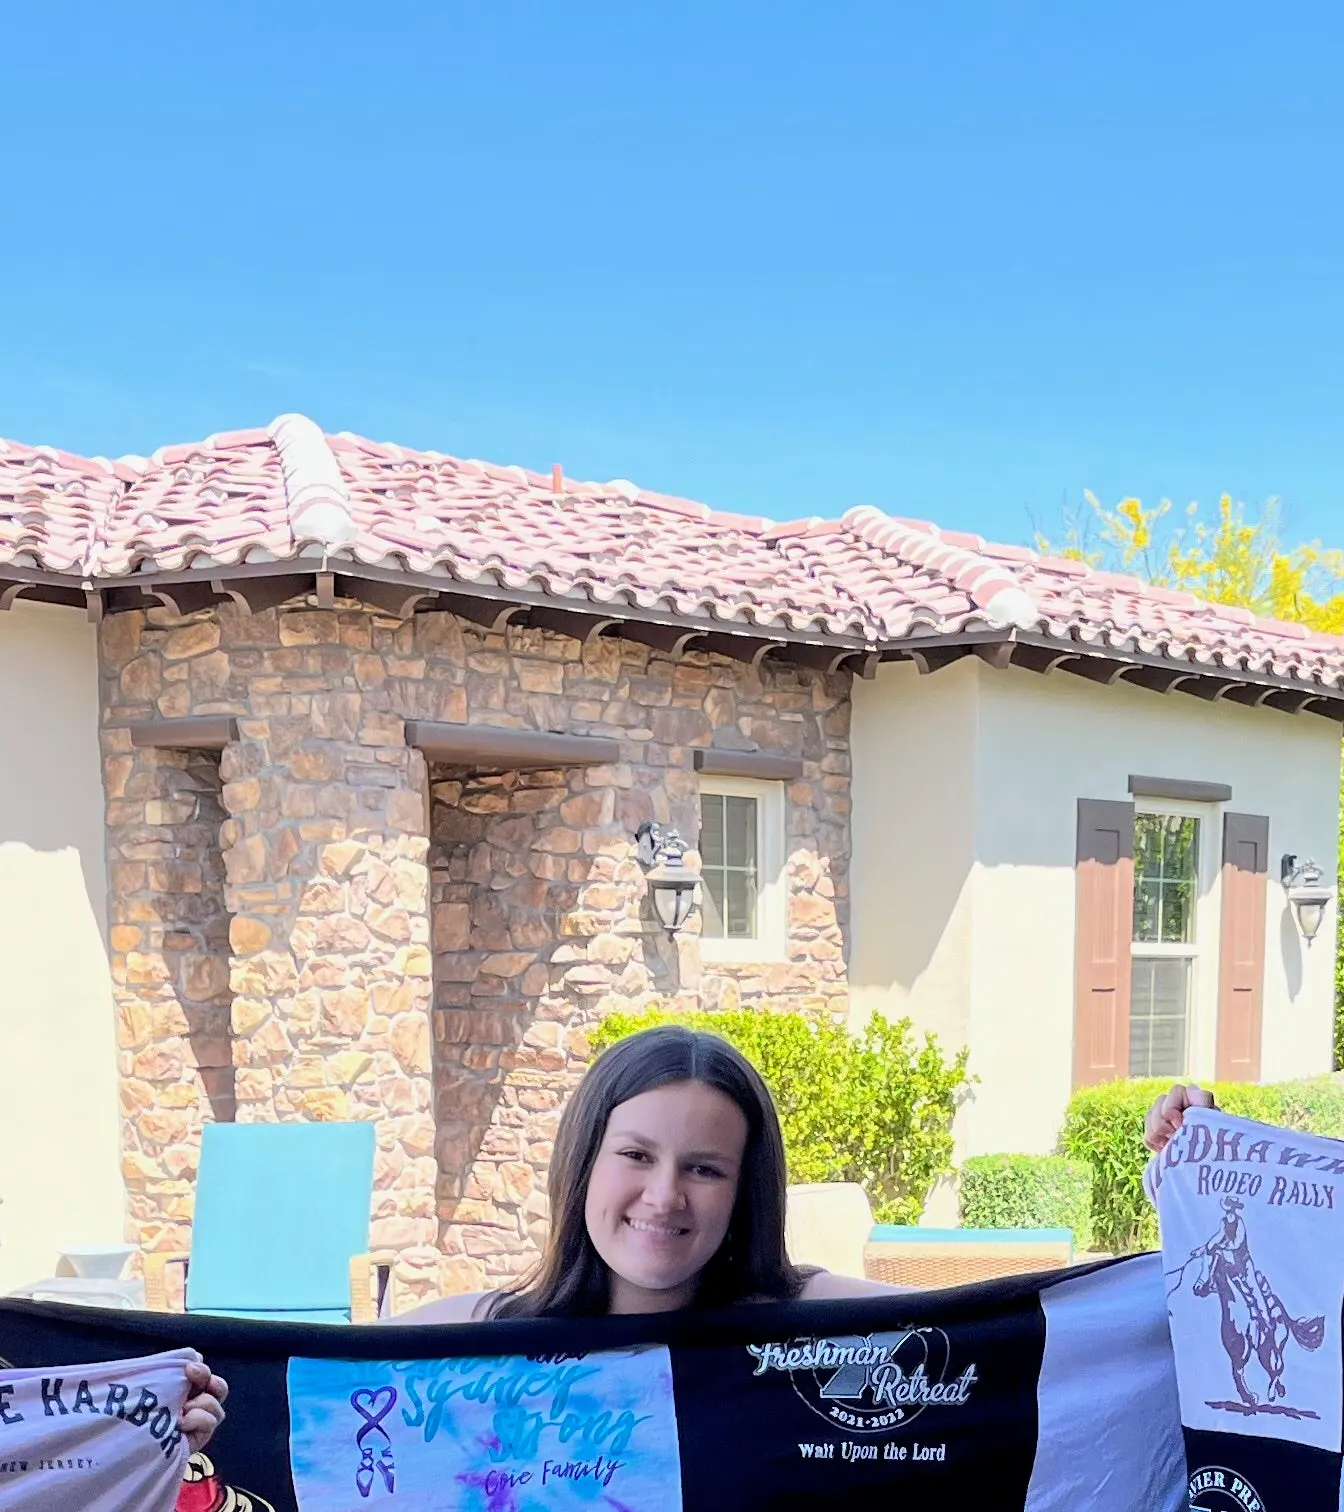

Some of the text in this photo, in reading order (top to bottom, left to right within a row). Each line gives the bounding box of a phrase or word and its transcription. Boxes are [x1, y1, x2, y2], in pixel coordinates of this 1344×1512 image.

[1197, 1164, 1335, 1209] RODEO RALLY
[401, 1365, 602, 1443] Sydney
[870, 1361, 980, 1408] Retreat
[40, 1378, 182, 1459] HARBOR
[488, 1405, 654, 1463] Strong
[38, 1458, 93, 1471] JERSEY
[542, 1455, 628, 1487] Family
[798, 1441, 946, 1463] Wait Upon the Lord
